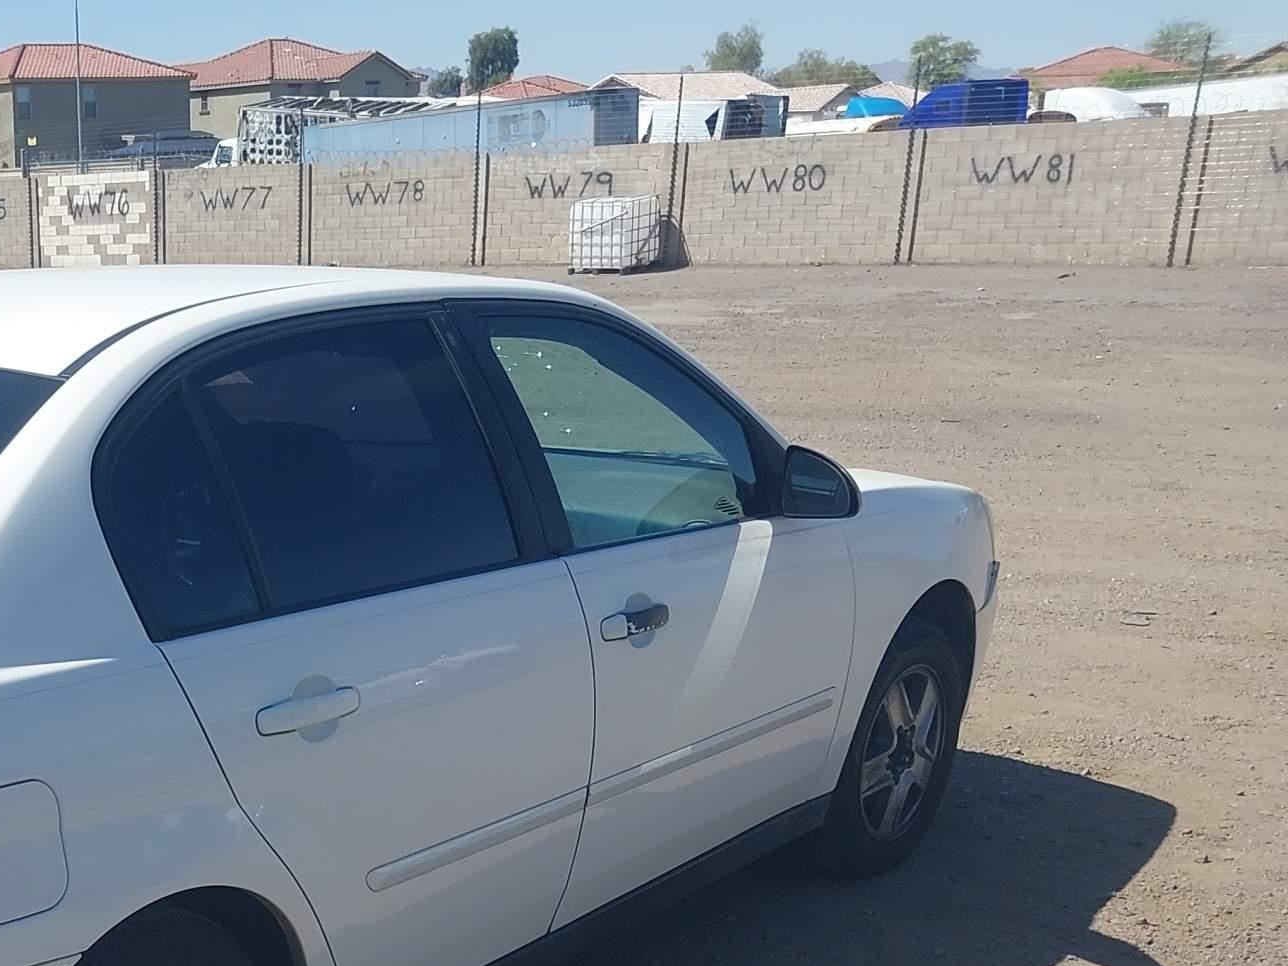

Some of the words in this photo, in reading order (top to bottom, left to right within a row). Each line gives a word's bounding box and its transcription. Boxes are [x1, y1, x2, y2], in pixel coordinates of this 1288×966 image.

[729, 164, 826, 194] WW80
[971, 153, 1075, 185] WW81
[199, 186, 273, 212] WW77
[345, 180, 426, 208] WW78
[524, 171, 613, 200] WW79
[66, 189, 130, 219] WW76
